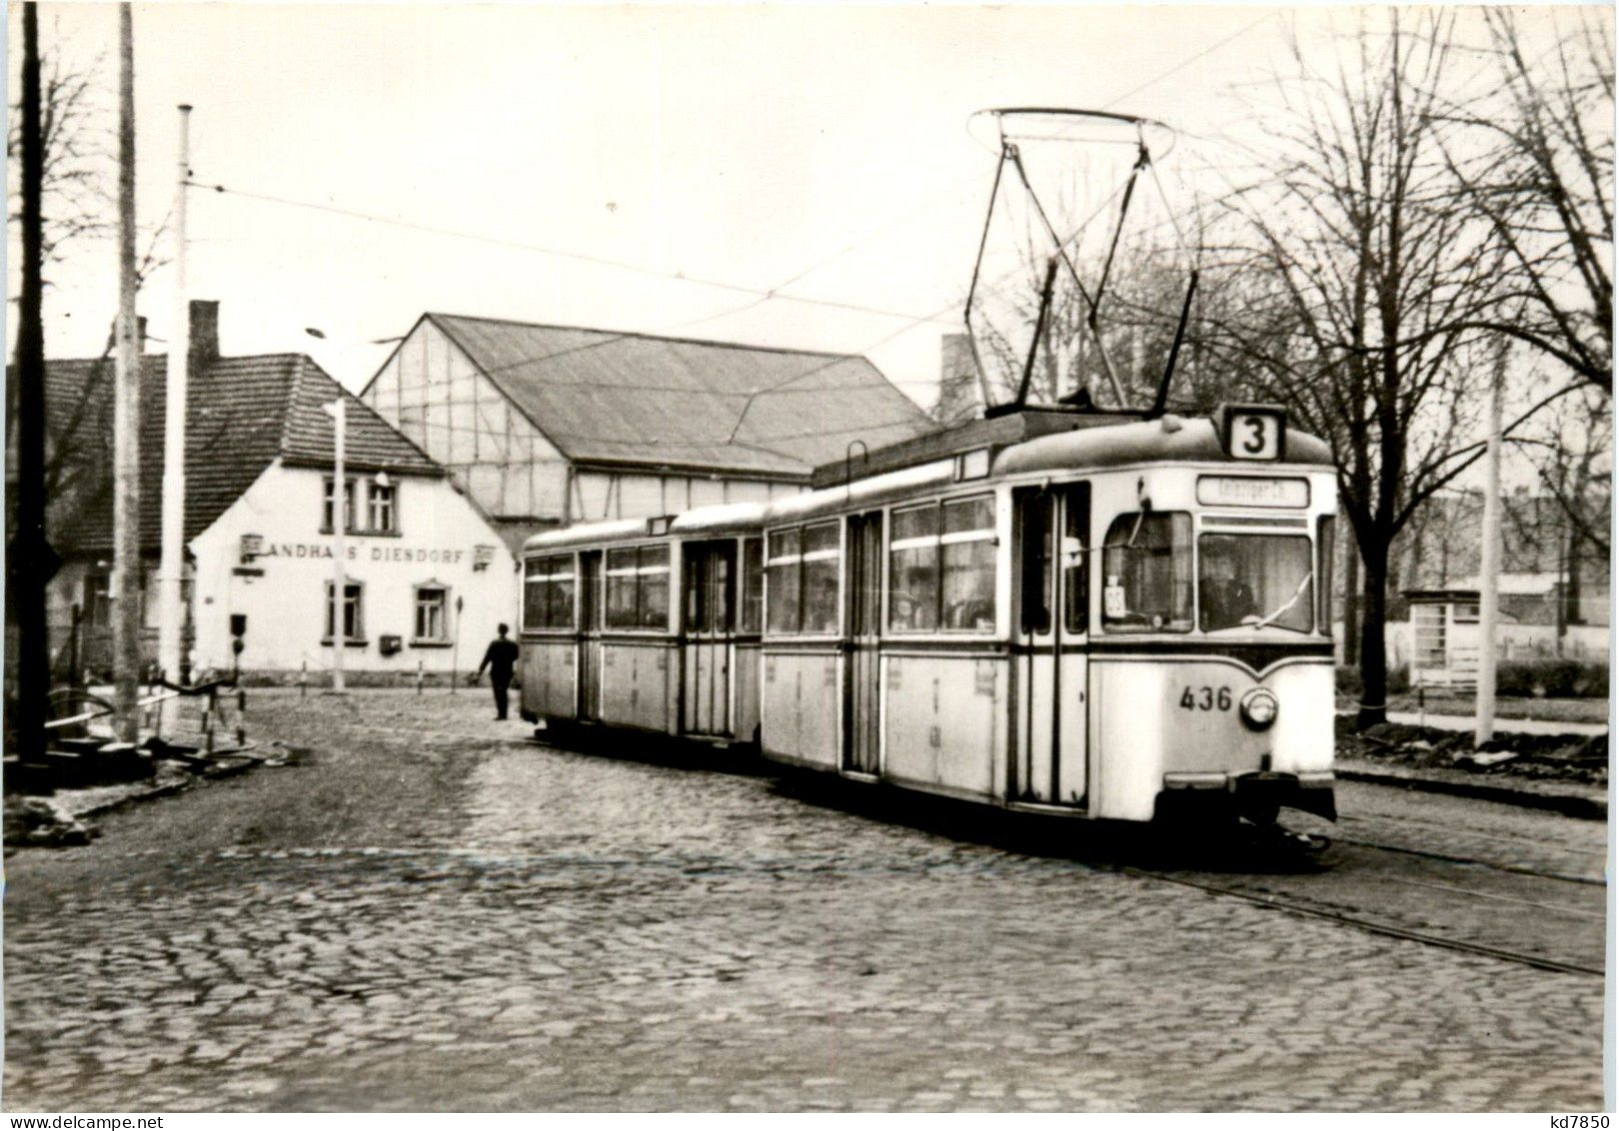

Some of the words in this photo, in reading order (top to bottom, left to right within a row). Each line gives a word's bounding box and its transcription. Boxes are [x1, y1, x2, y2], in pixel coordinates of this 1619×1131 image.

[1243, 417, 1265, 454] 3
[264, 543, 357, 560] ANDHAS
[371, 546, 464, 564] DIESDORF
[1179, 685, 1232, 712] 436
